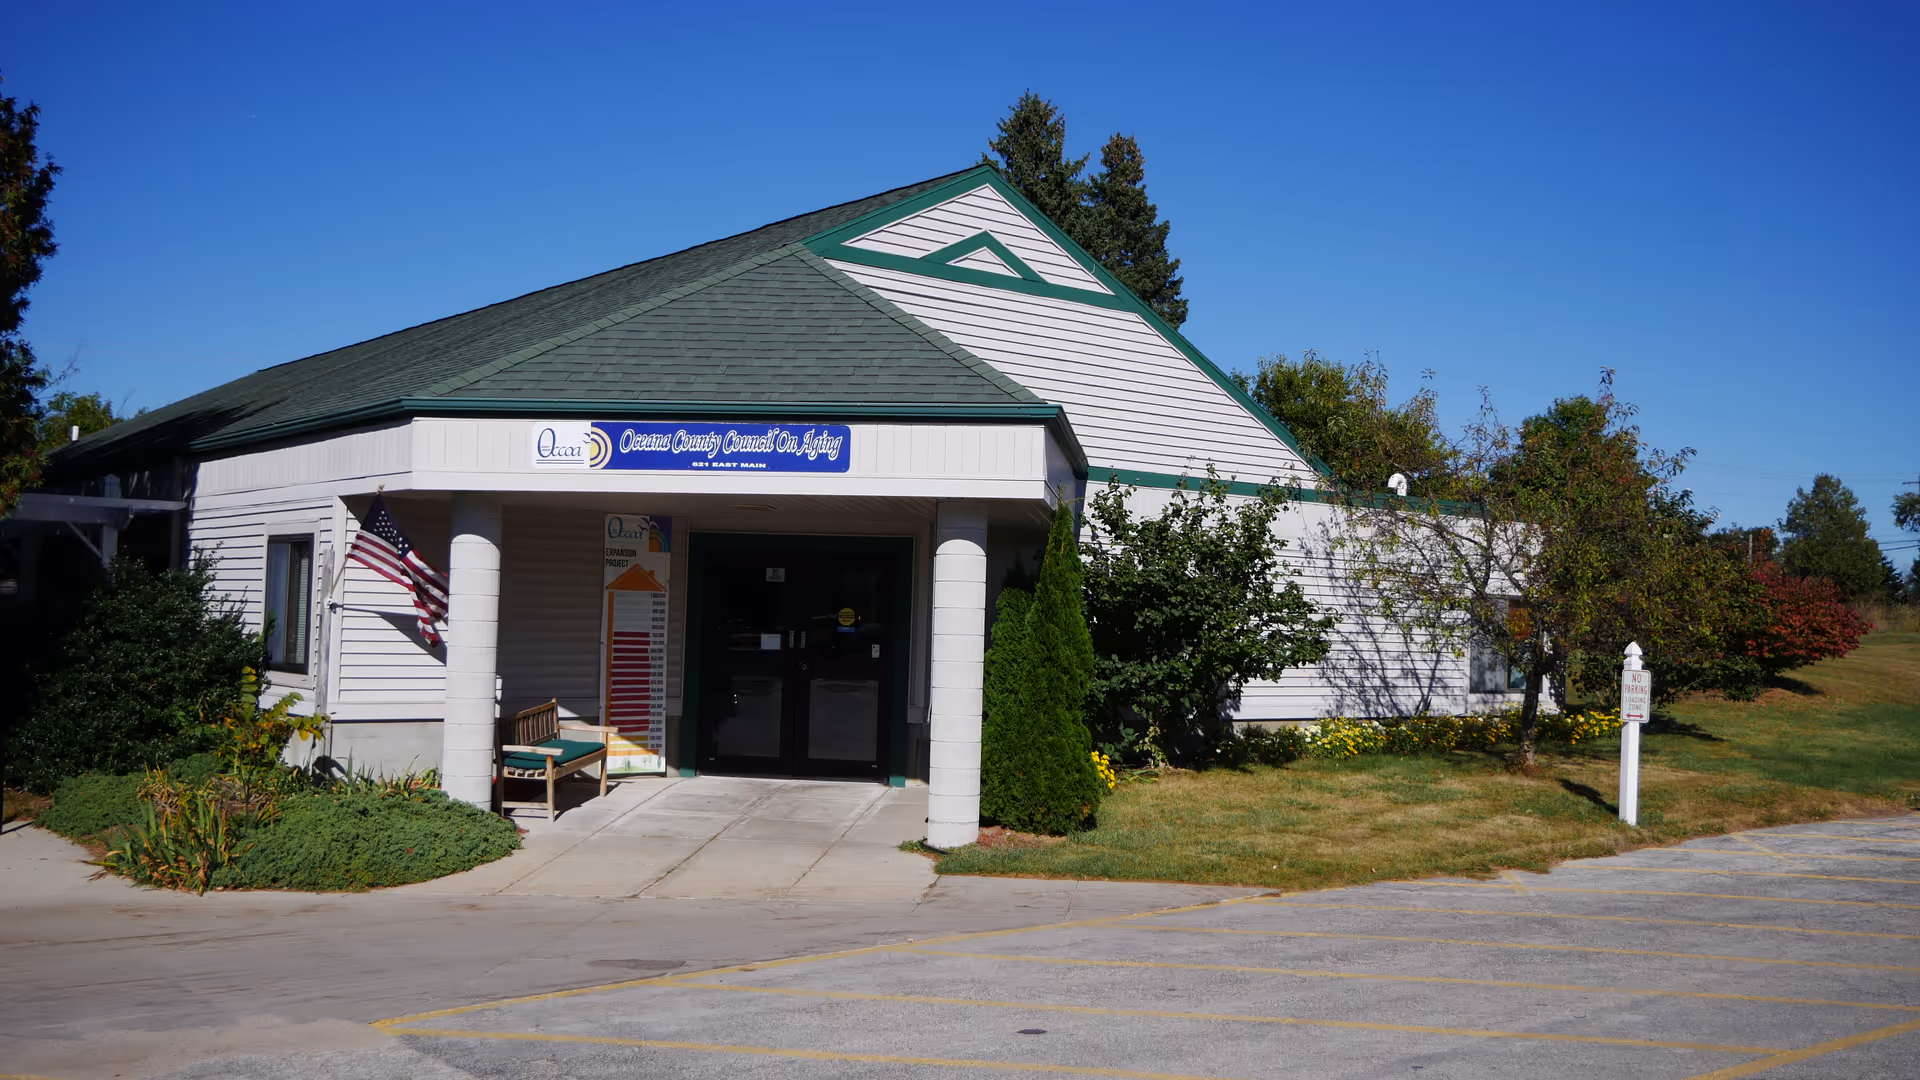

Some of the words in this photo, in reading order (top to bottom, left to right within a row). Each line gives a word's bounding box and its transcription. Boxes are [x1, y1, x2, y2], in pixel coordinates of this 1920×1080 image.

[619, 428, 672, 453] Oceana
[671, 429, 722, 459] County
[722, 427, 780, 455] Council
[776, 430, 798, 453] On
[795, 428, 843, 460] Aging
[606, 548, 637, 557] EXPANSION
[606, 558, 630, 567] PROJECT
[1632, 674, 1642, 683] NO
[1625, 684, 1647, 694] PARKING
